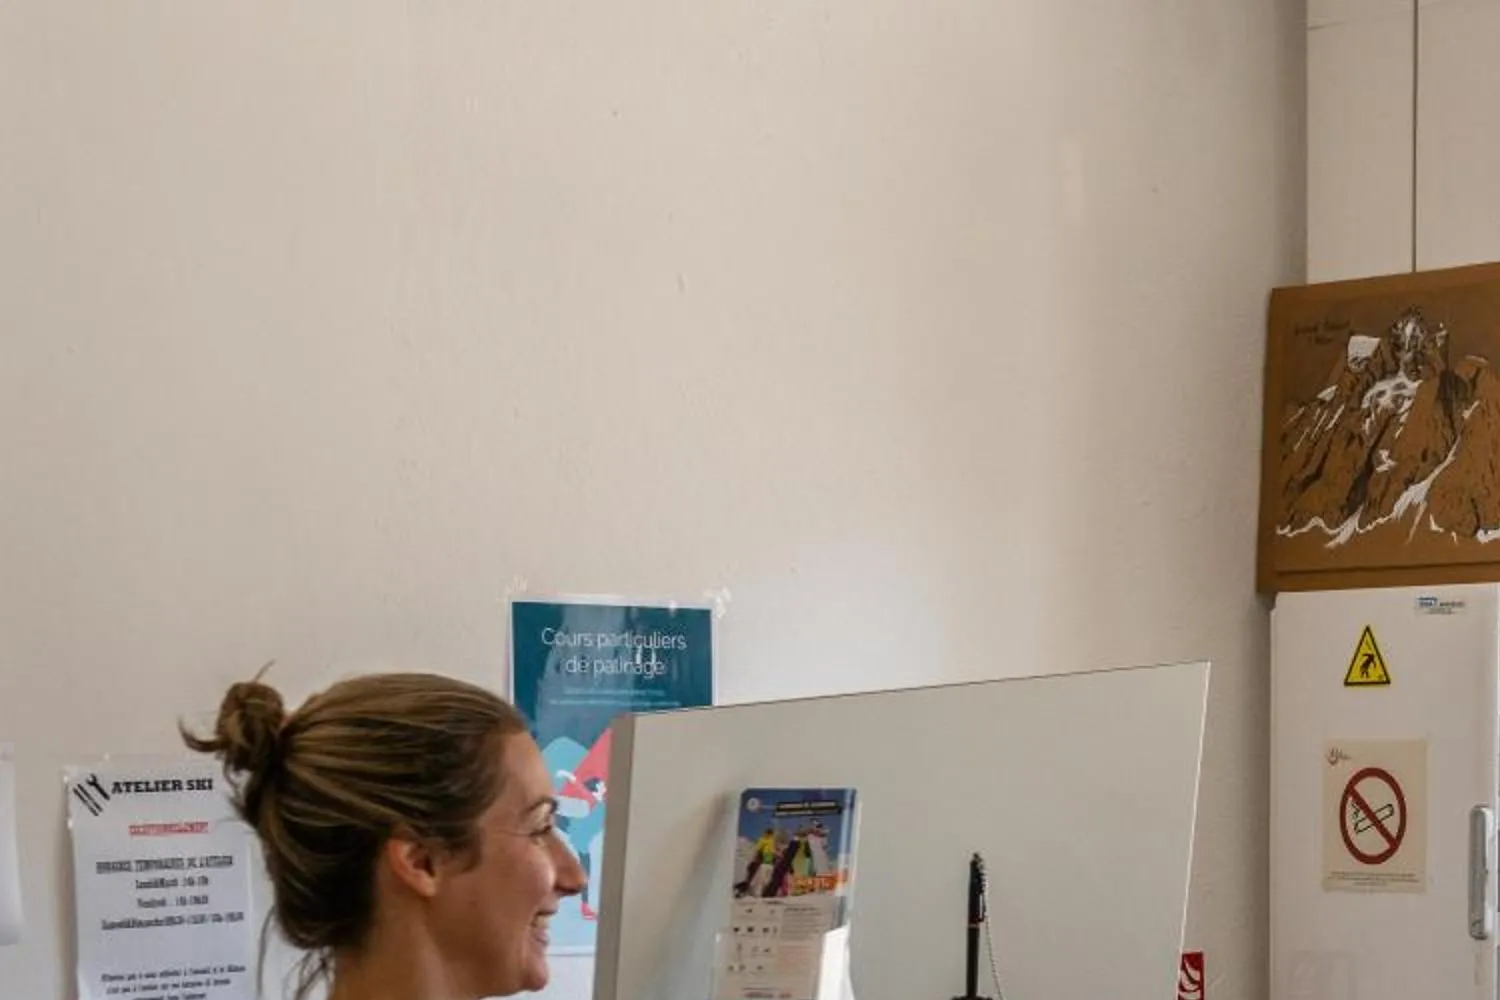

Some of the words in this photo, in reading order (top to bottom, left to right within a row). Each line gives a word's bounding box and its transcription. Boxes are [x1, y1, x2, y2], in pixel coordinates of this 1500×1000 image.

[541, 627, 593, 647] Cours
[597, 630, 687, 651] particuliers
[566, 656, 589, 673] de
[594, 655, 666, 679] patinage
[112, 780, 182, 794] ATELIER
[186, 778, 213, 791] SKI
